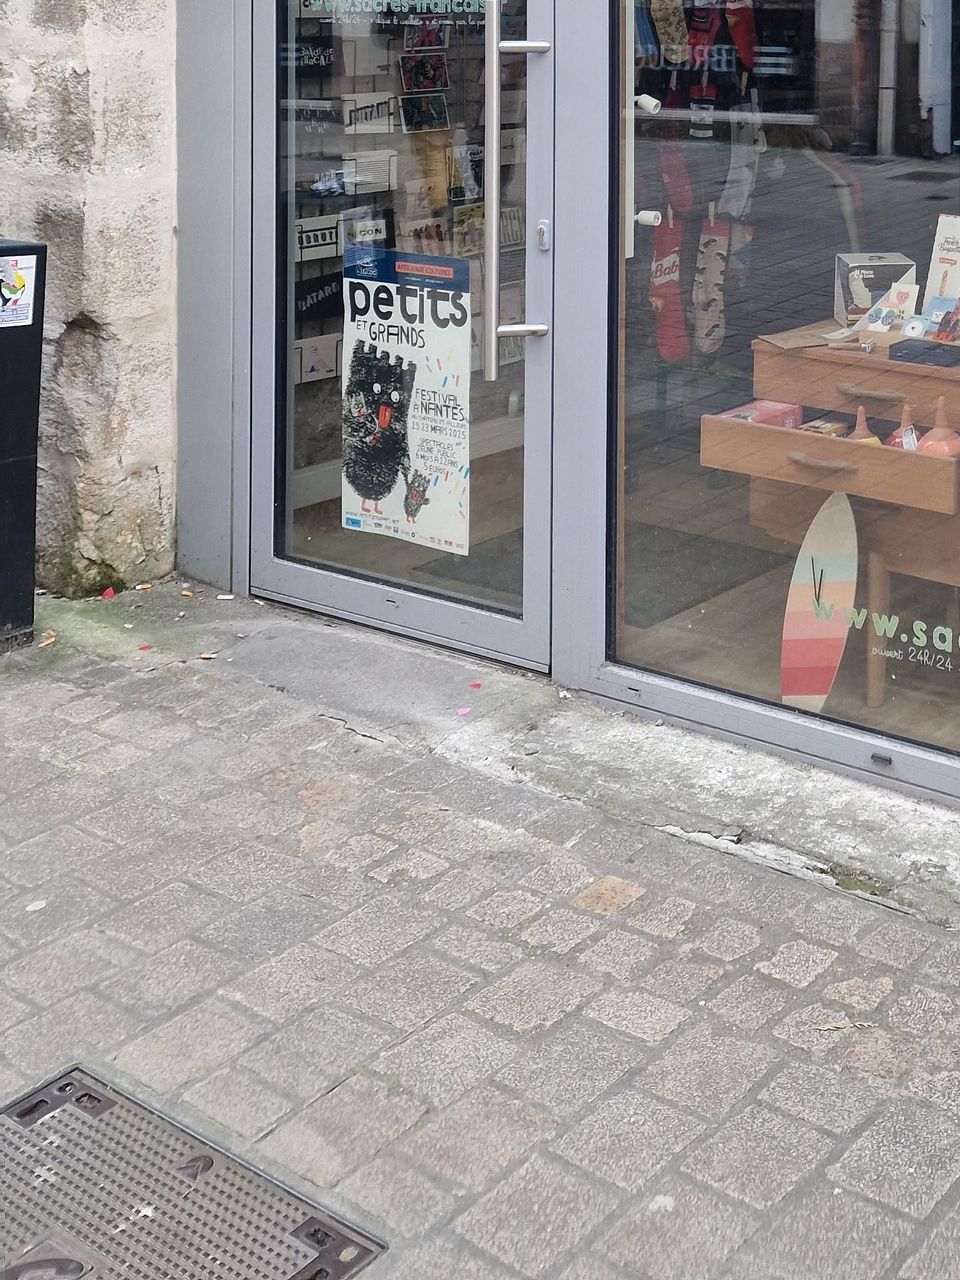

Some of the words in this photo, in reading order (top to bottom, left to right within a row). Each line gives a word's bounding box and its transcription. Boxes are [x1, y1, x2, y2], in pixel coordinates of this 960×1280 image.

[360, 228, 383, 237] CON
[348, 280, 468, 329] petits
[356, 319, 368, 330] ET
[369, 321, 426, 349] GRANDS
[415, 388, 461, 407] FESTIVAL
[420, 401, 465, 421] NANTES
[430, 425, 448, 435] MARS
[448, 428, 467, 440] 2025
[872, 646, 904, 662] ouvert
[908, 648, 953, 672] 24h/24
